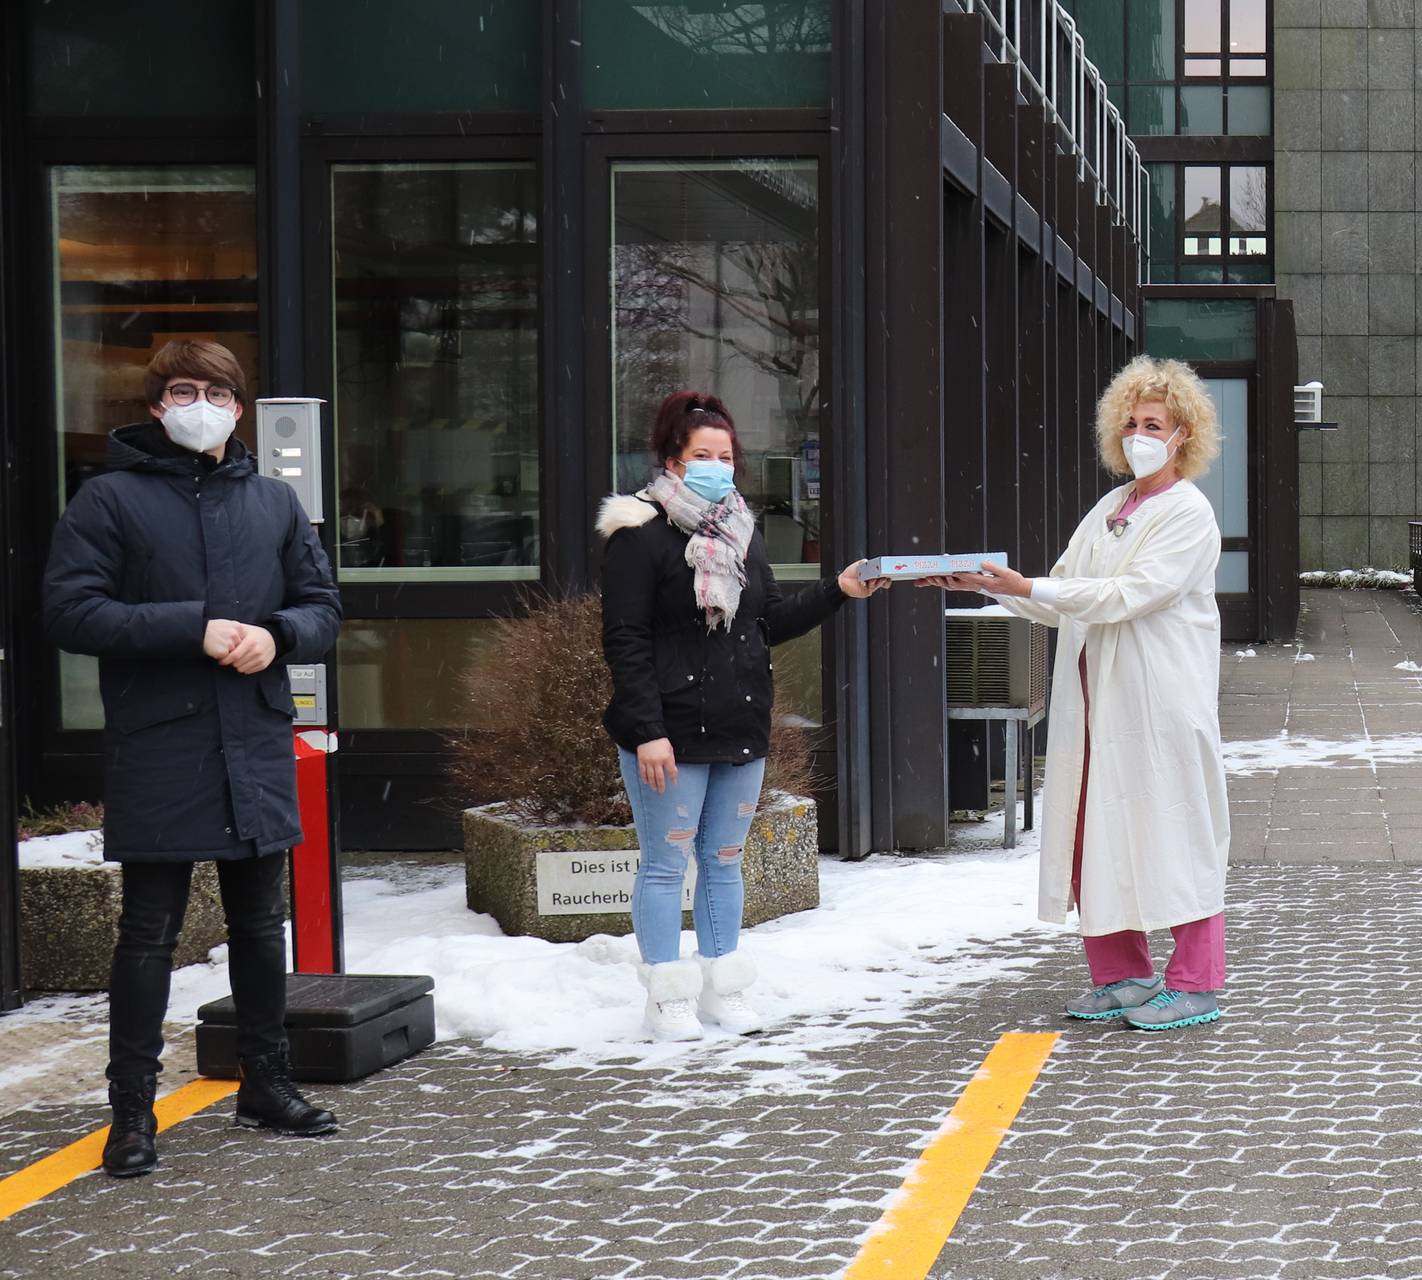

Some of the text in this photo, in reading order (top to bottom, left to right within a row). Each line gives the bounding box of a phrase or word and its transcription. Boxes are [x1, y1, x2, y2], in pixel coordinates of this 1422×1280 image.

[571, 860, 606, 874] Dies
[611, 860, 631, 873] ist
[552, 889, 632, 906] Raucherb
